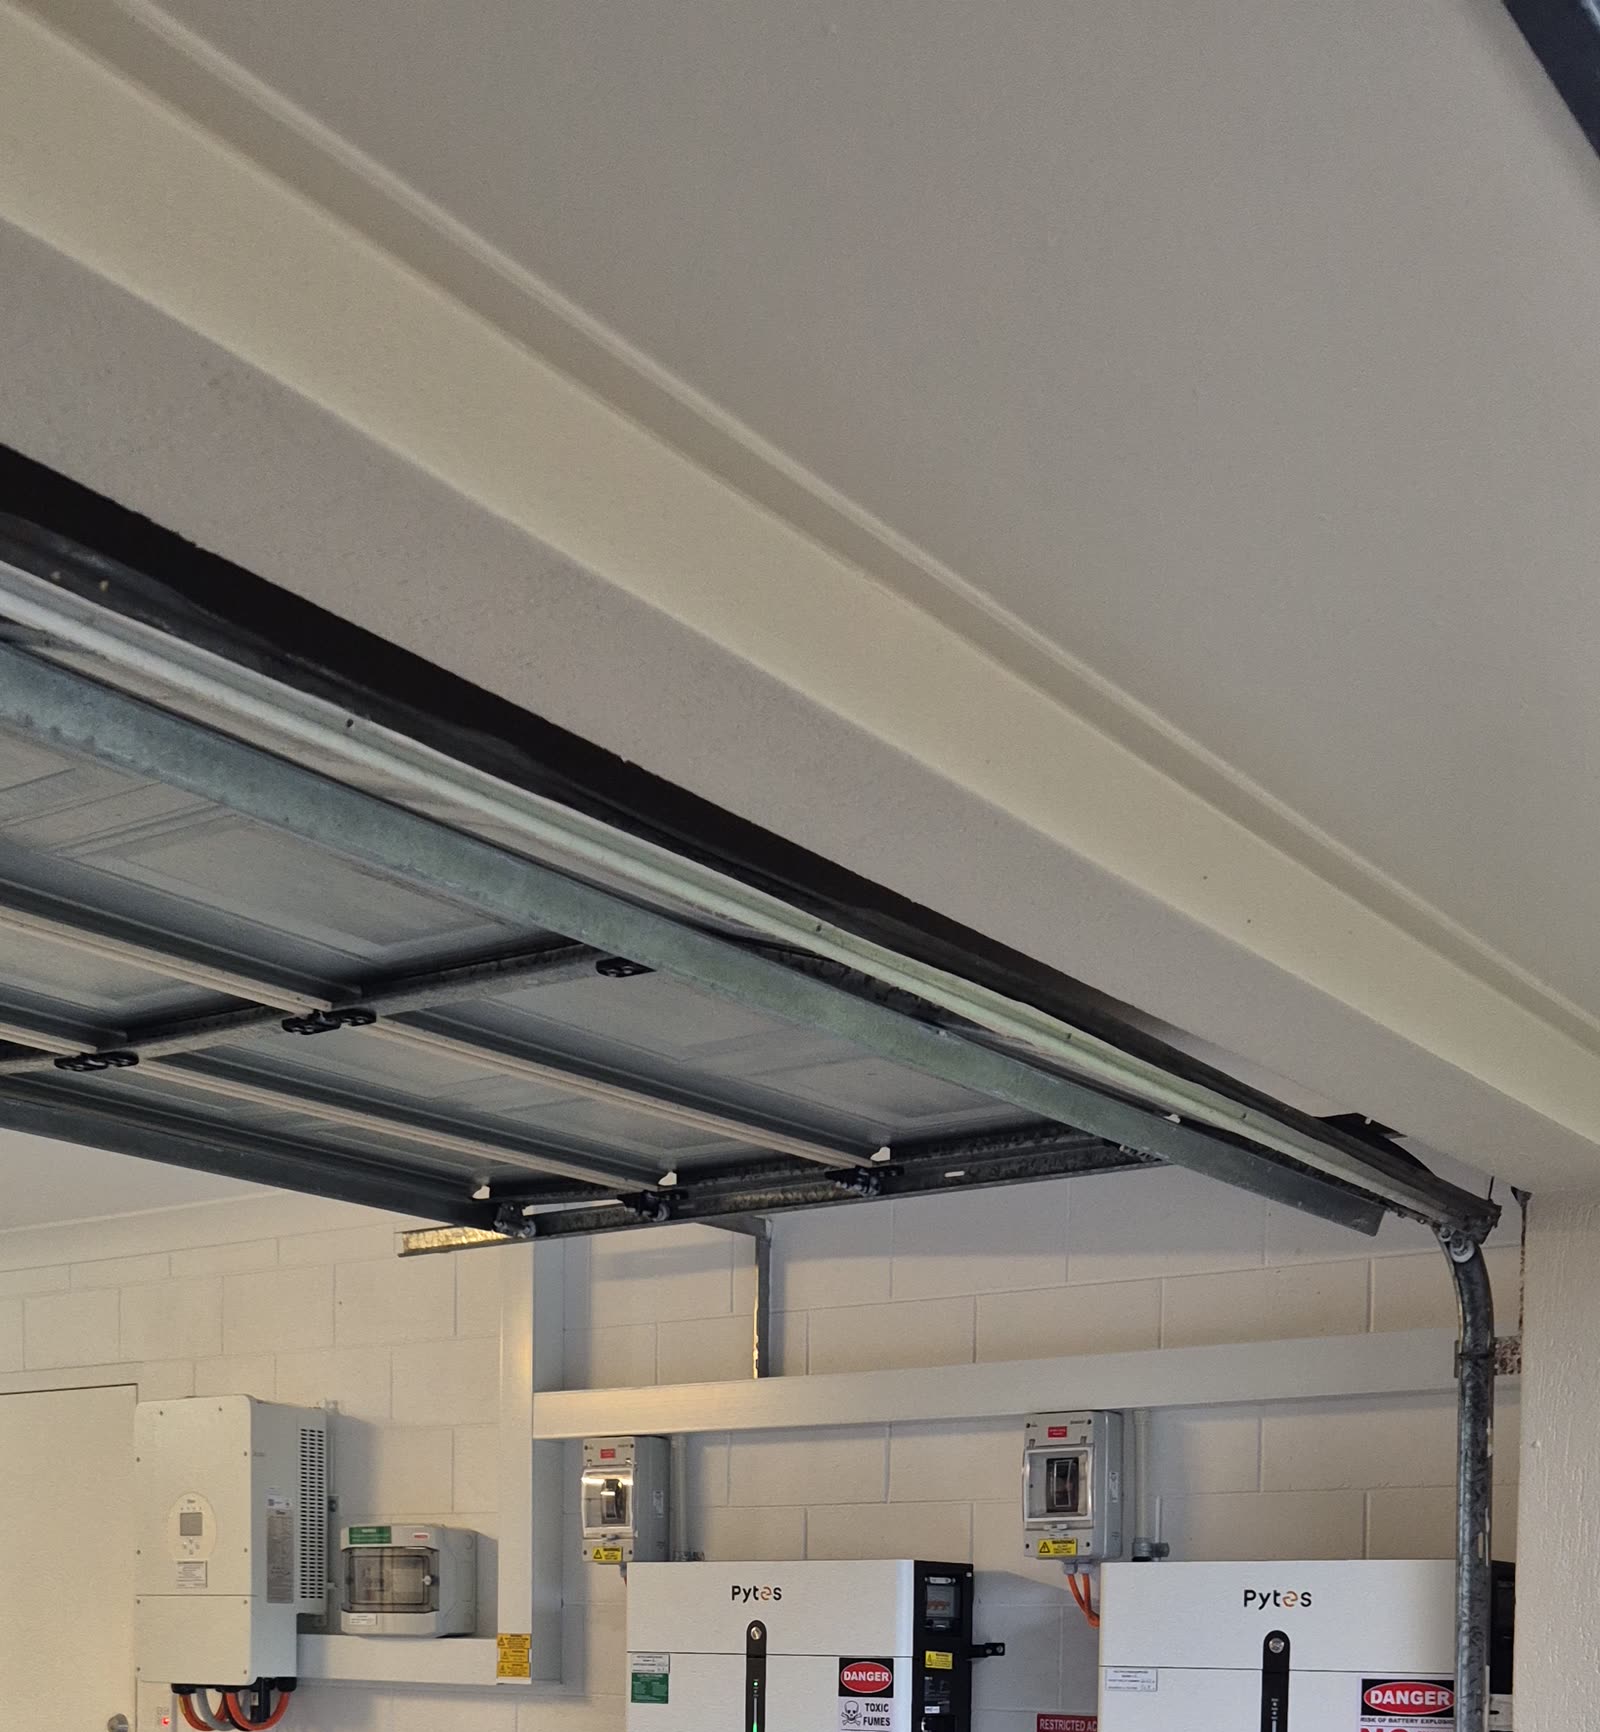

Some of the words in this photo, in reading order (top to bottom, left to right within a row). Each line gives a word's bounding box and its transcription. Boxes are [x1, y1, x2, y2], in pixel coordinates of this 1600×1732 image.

[731, 1585, 782, 1603] Pytes
[1243, 1589, 1312, 1610] Pytes
[843, 1671, 889, 1682] DANGER
[1370, 1690, 1450, 1706] DANGER
[865, 1703, 889, 1713] TOXIC
[863, 1717, 891, 1726] FUMES
[1040, 1718, 1086, 1732] RESTRICTED
